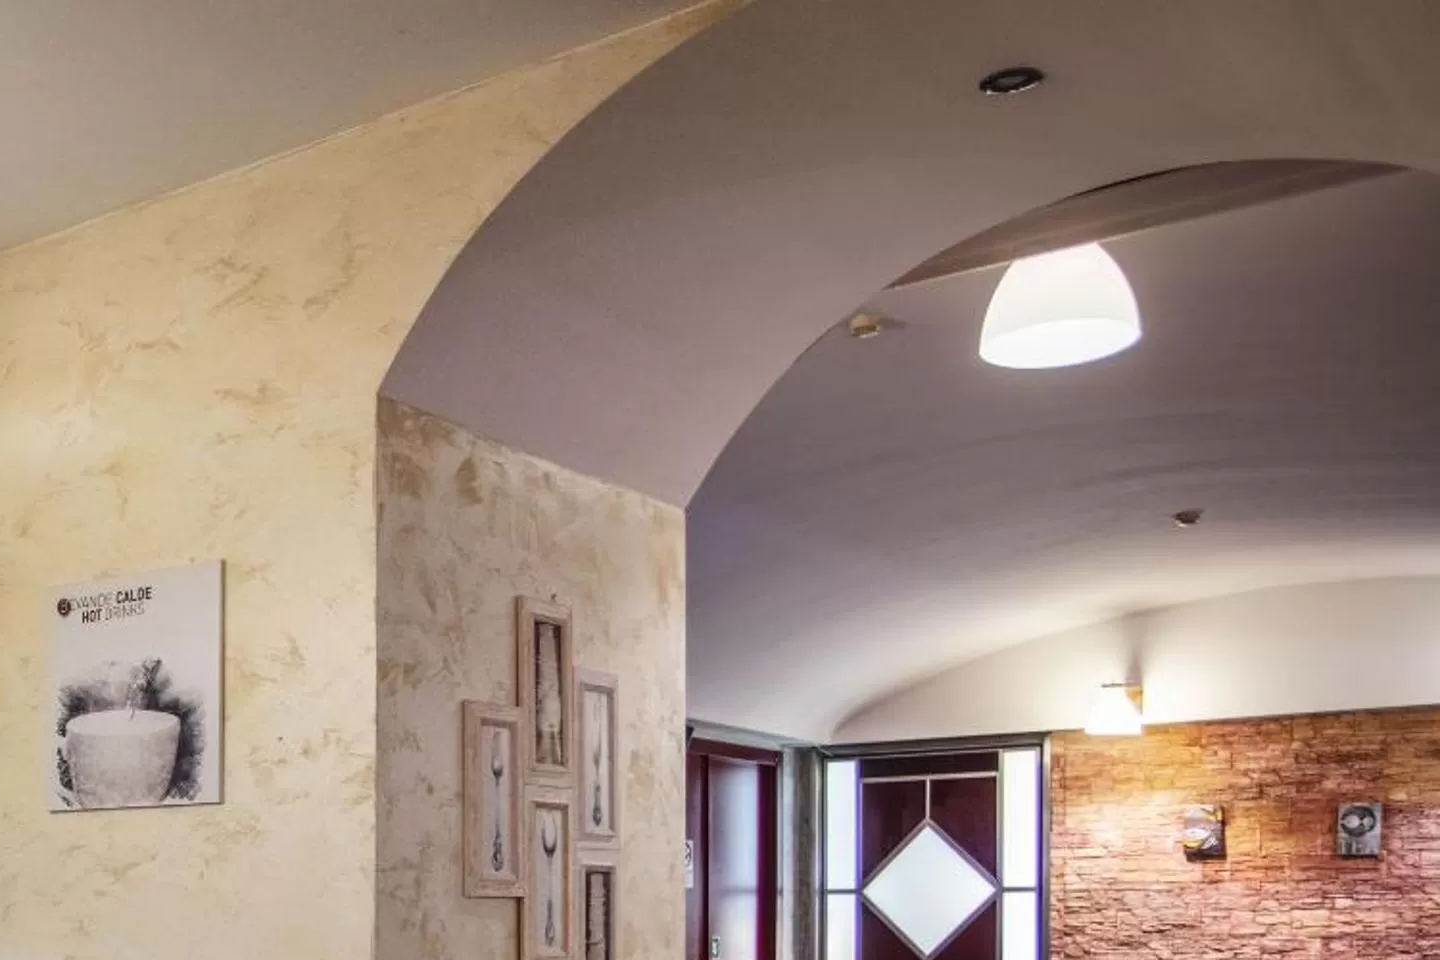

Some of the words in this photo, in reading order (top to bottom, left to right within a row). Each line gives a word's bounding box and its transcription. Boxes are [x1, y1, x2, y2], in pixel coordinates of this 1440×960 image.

[116, 586, 152, 604] CALDE
[82, 608, 102, 624] HOT
[104, 602, 145, 621] DRINKS
